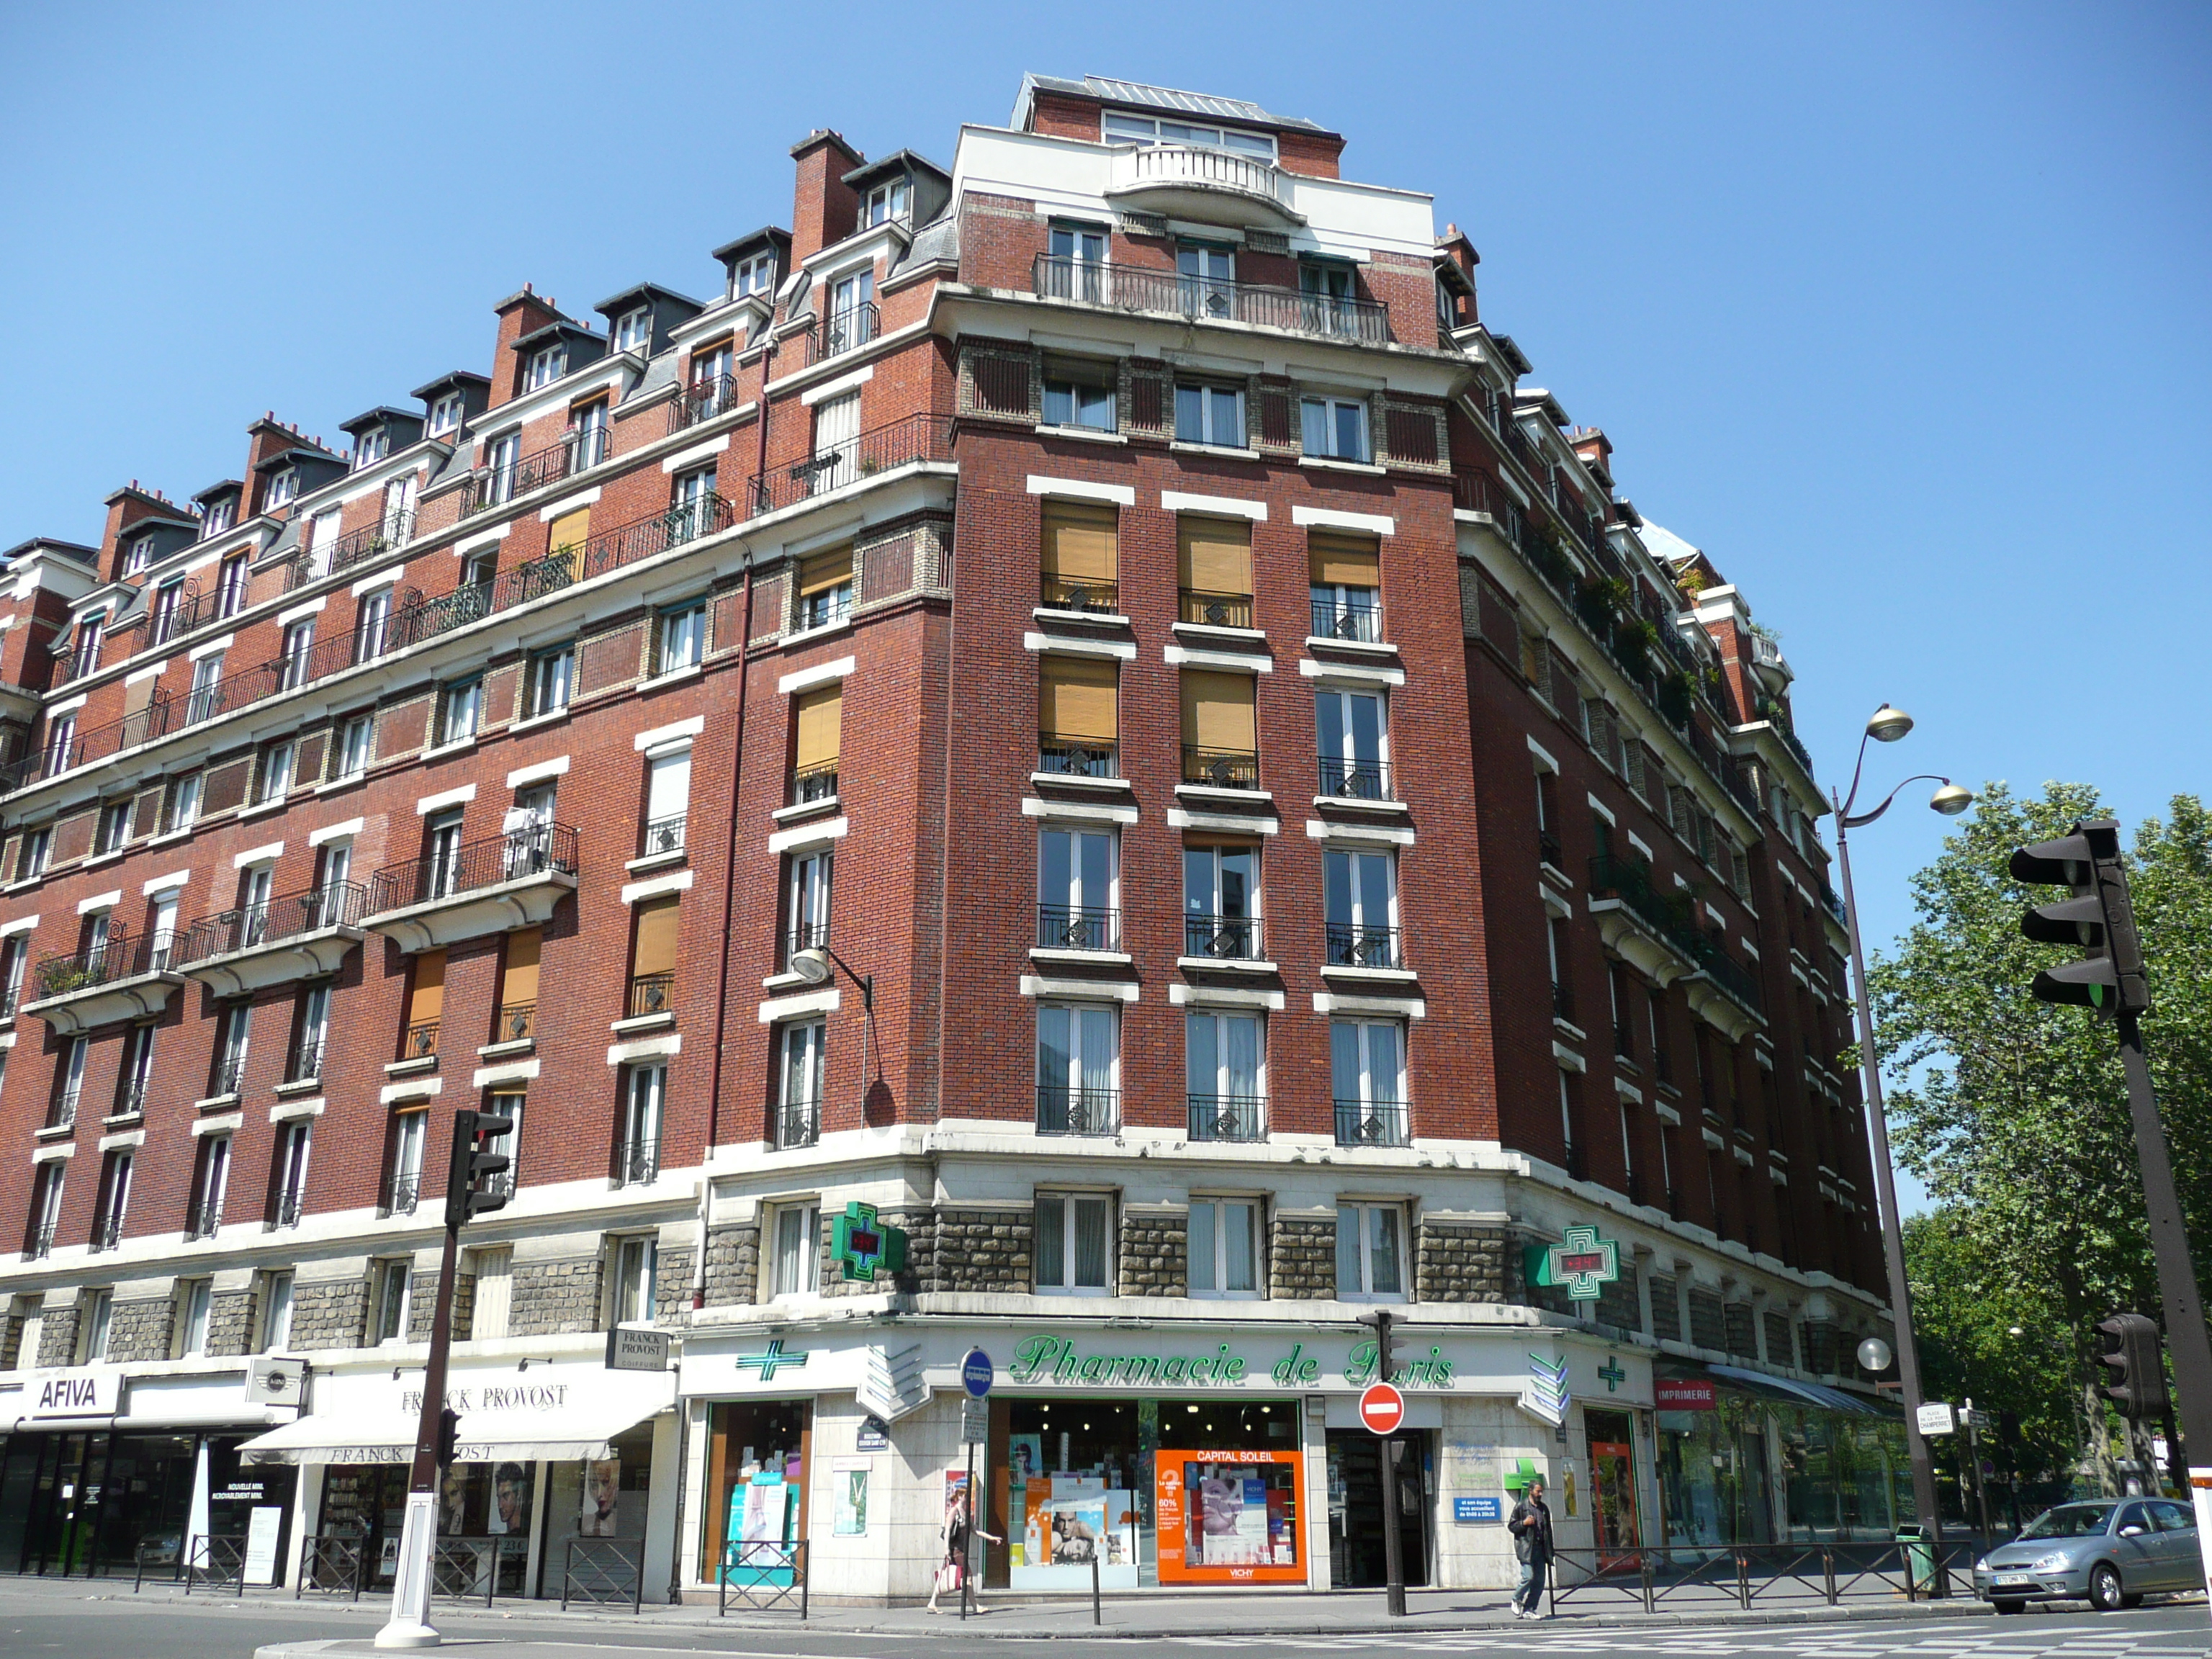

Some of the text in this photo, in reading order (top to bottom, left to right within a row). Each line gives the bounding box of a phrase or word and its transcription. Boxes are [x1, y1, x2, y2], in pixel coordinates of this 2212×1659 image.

[625, 1332, 660, 1344] FRANCK
[622, 1344, 661, 1355] PROVOST
[1009, 1335, 1245, 1380] Pharmacie
[1272, 1344, 1318, 1381] de
[39, 1378, 96, 1408] AFIVA
[403, 1385, 567, 1411] FRCK PROVOST
[1658, 1390, 1711, 1401] IMPRIMERIE
[331, 1448, 404, 1462] FRANCK
[1197, 1451, 1274, 1462] CAPITAL SOLEIL
